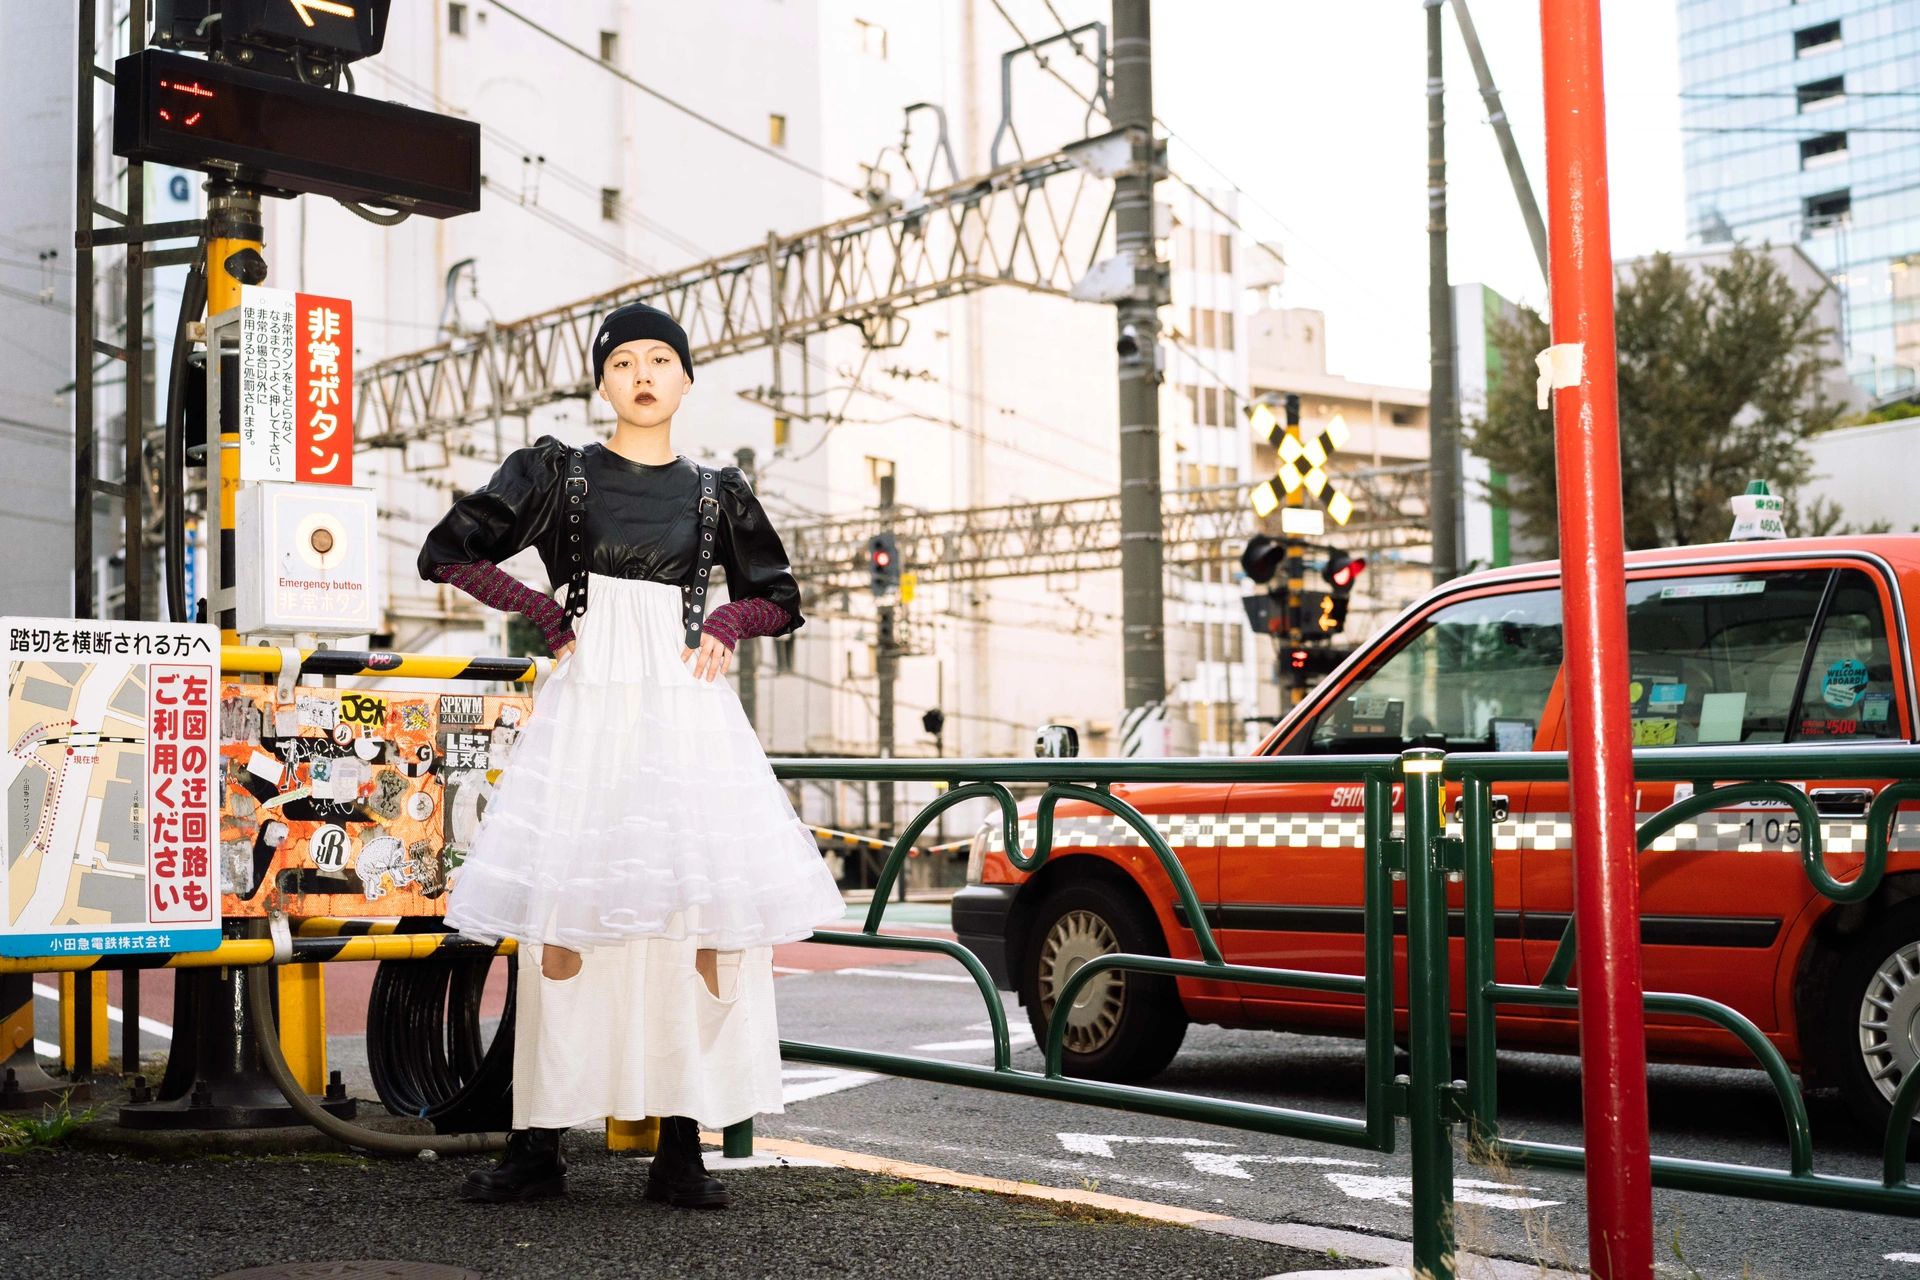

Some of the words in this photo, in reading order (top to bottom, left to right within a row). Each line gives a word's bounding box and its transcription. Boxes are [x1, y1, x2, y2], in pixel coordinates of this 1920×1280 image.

[243, 307, 256, 446] 使用すると処罰されます。
[256, 308, 268, 405] 非常の場合以外に
[282, 312, 294, 444] 非常ボタンをもどらなく
[269, 309, 281, 472] なるまでつよく押して下さい。
[307, 306, 341, 475] 非常ボタン
[279, 577, 331, 591] Emergency
[333, 580, 363, 591] button
[279, 592, 366, 614] 非常ボタン
[9, 627, 212, 657] 踏切を横断される方へ
[1827, 668, 1867, 678] WELCOME
[73, 755, 100, 765] 現在地
[152, 673, 180, 912] ご利用ください
[181, 674, 209, 912] 左図の迂回路も
[1745, 818, 1801, 844] 105
[49, 933, 172, 952] 小田急電鉄株式会社
